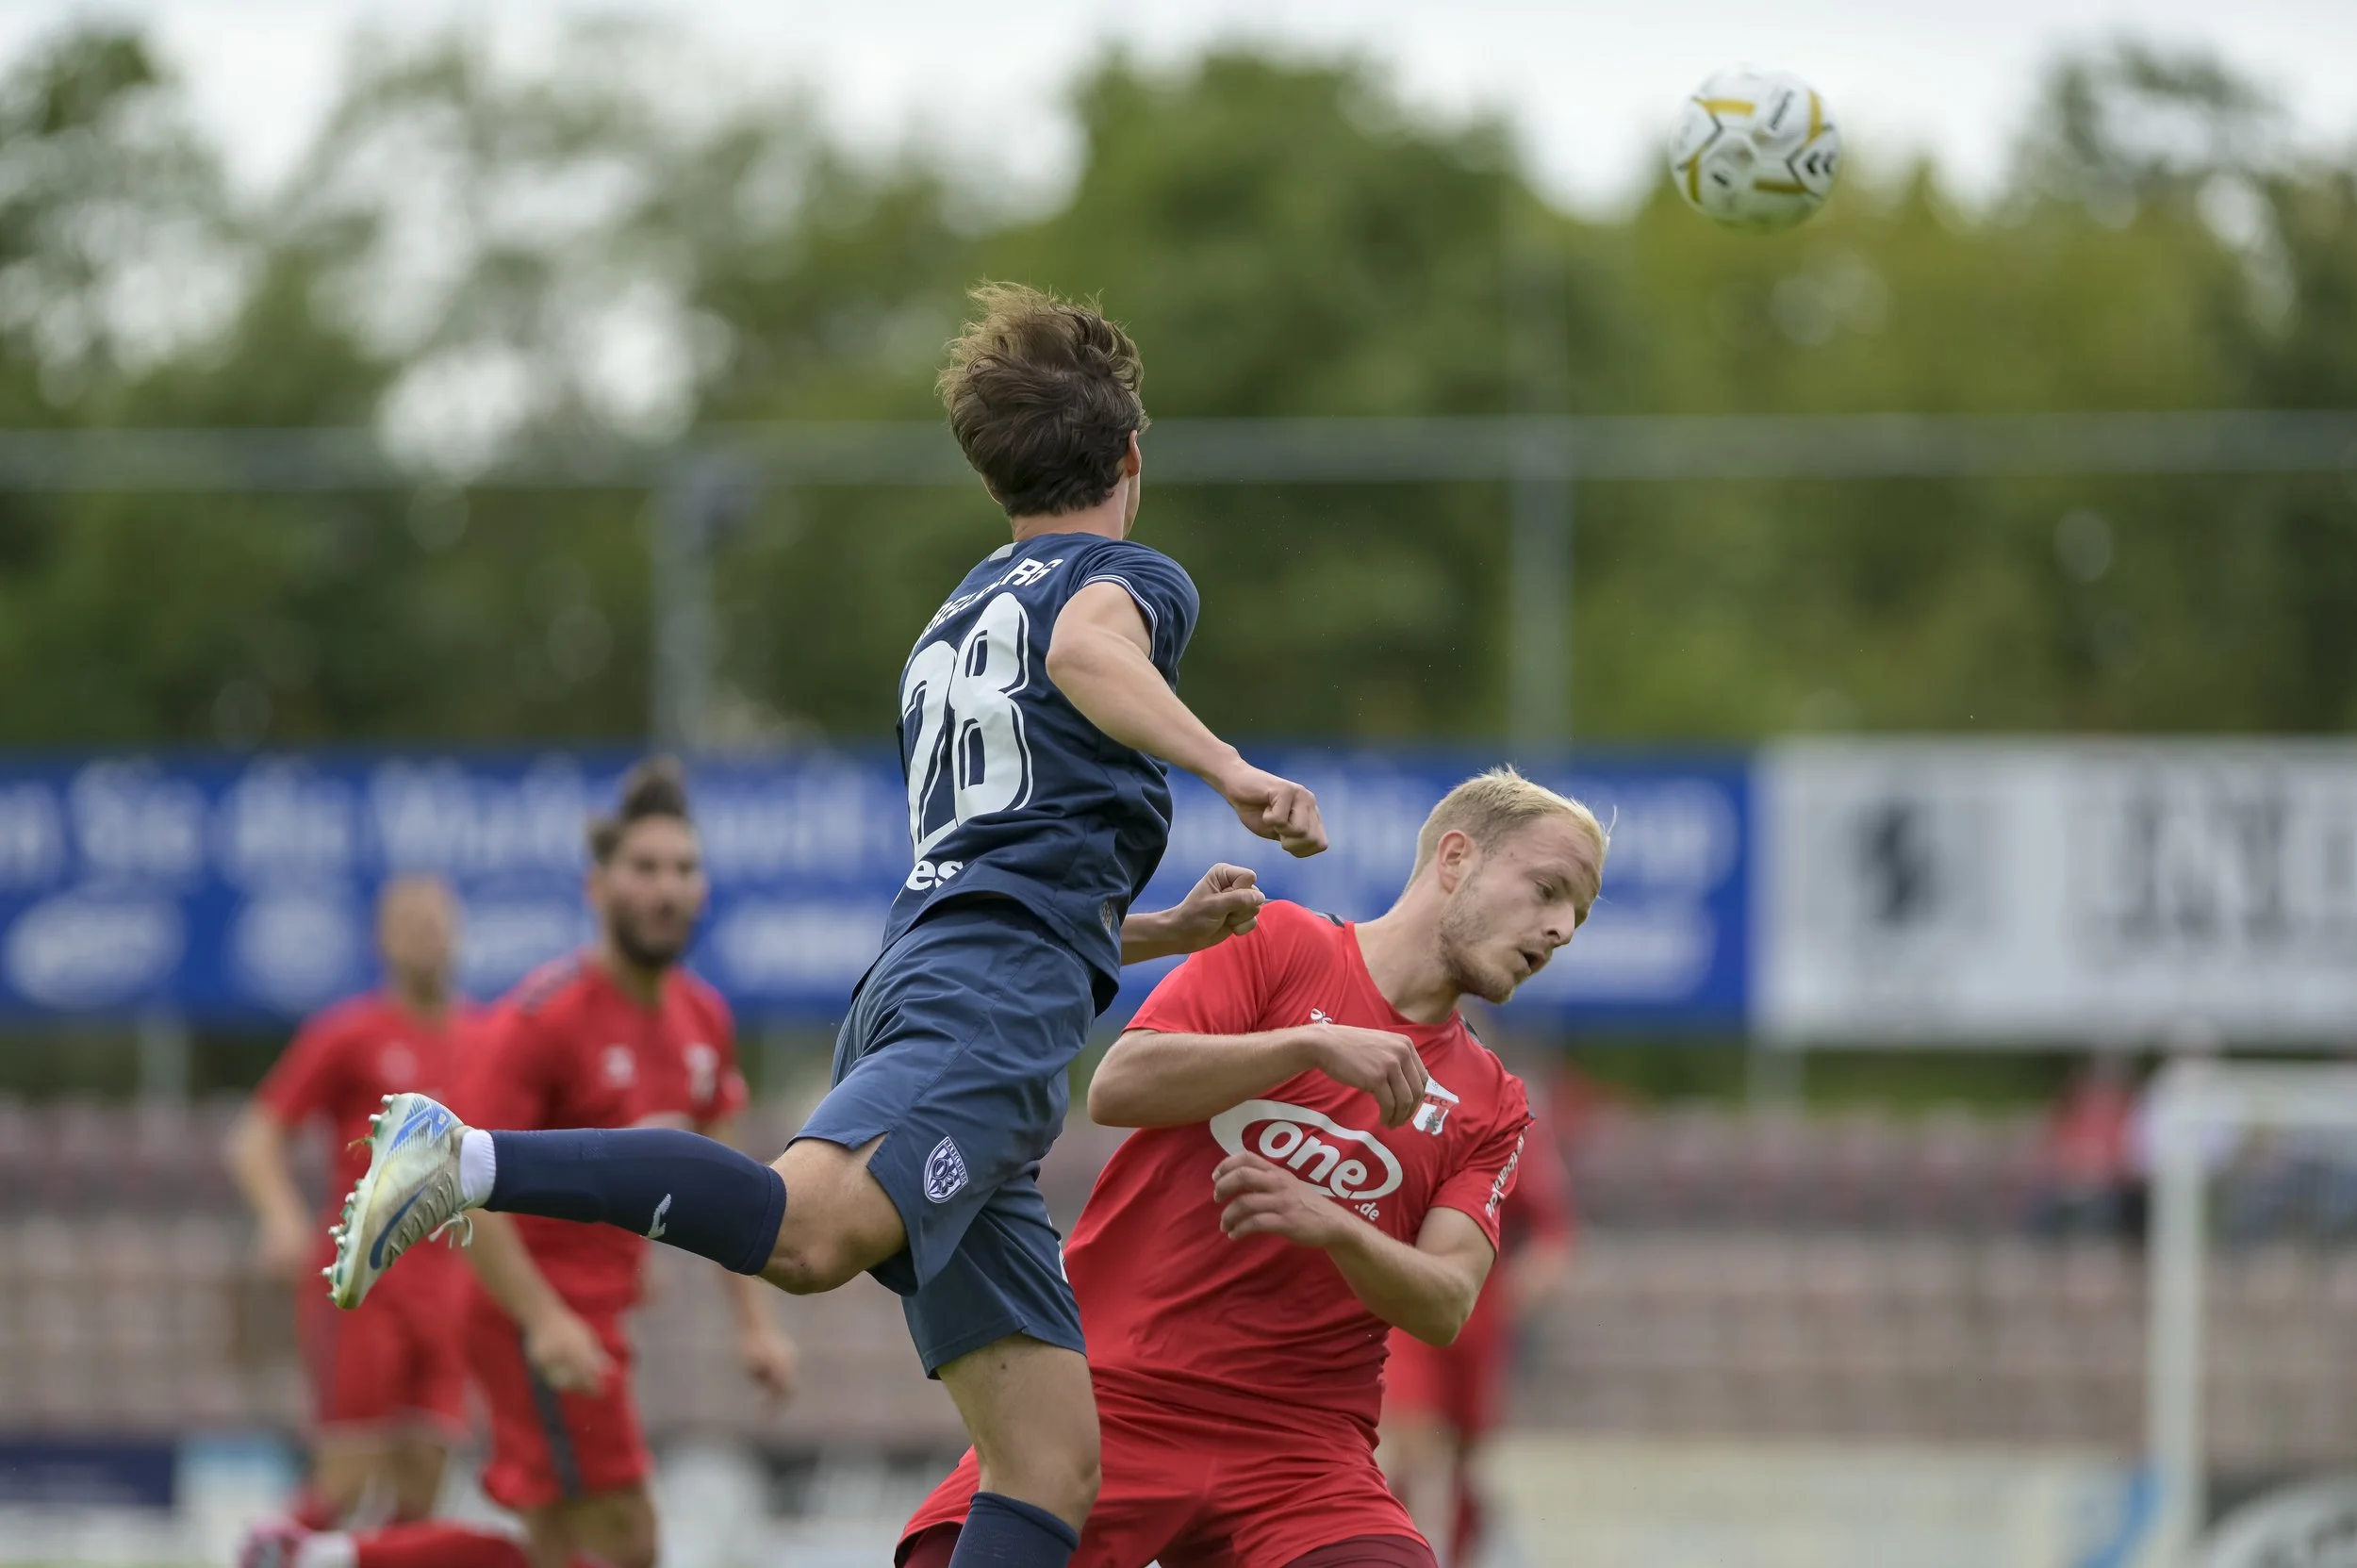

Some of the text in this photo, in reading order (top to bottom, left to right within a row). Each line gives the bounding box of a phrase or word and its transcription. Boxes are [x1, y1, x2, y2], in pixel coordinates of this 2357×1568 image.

[901, 591, 1033, 865] 28
[1259, 1120, 1368, 1199] one
[1354, 1201, 1380, 1221] .de
